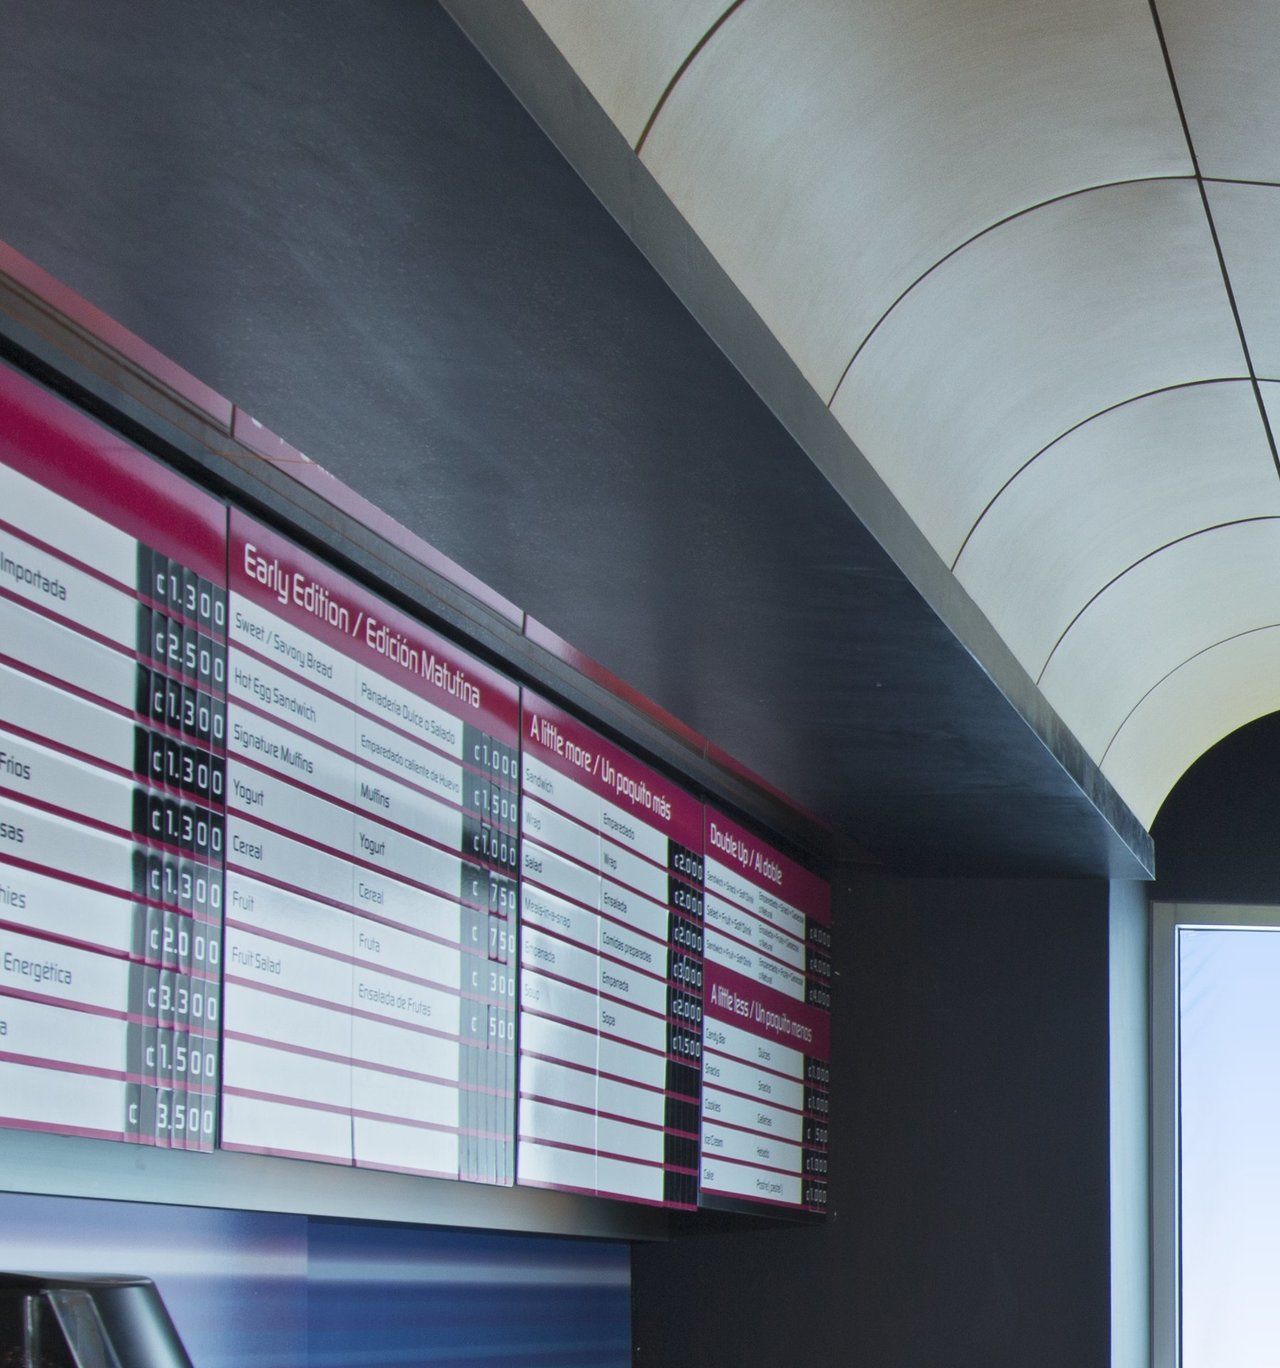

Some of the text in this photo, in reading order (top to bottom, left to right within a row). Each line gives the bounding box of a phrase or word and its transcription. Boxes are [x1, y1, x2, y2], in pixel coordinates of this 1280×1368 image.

[0, 551, 67, 602] Importada
[244, 543, 481, 709] Early Edition / Edición Matutina
[235, 613, 265, 643] Sweet
[274, 634, 306, 669] Savory
[307, 655, 333, 680] Bread
[235, 666, 317, 723] Hot Egg Sandwich
[233, 724, 313, 775] Signature Muffins
[530, 714, 540, 741] A
[541, 719, 564, 756] little
[565, 740, 592, 772] more
[601, 757, 615, 788] Un
[616, 772, 652, 809] poquito
[652, 794, 672, 822] más
[233, 779, 264, 807] Yogurt
[360, 782, 390, 809] Muffins
[233, 835, 263, 860] Cereal
[359, 831, 386, 857] Yogurt
[710, 822, 738, 858] Double
[737, 838, 749, 868] Up
[525, 853, 543, 874] Salad
[232, 891, 254, 913] Fruit
[358, 882, 384, 906] Cereal
[358, 932, 381, 954] Fruta
[3, 951, 72, 985] Energética
[232, 946, 281, 975] Fruit Salad
[358, 983, 395, 1008] Ensalada
[490, 973, 515, 998] 300
[711, 984, 718, 1004] A
[718, 986, 733, 1010] little
[735, 996, 749, 1018] less
[490, 1018, 514, 1041] 500
[157, 1102, 213, 1135] 3.500
